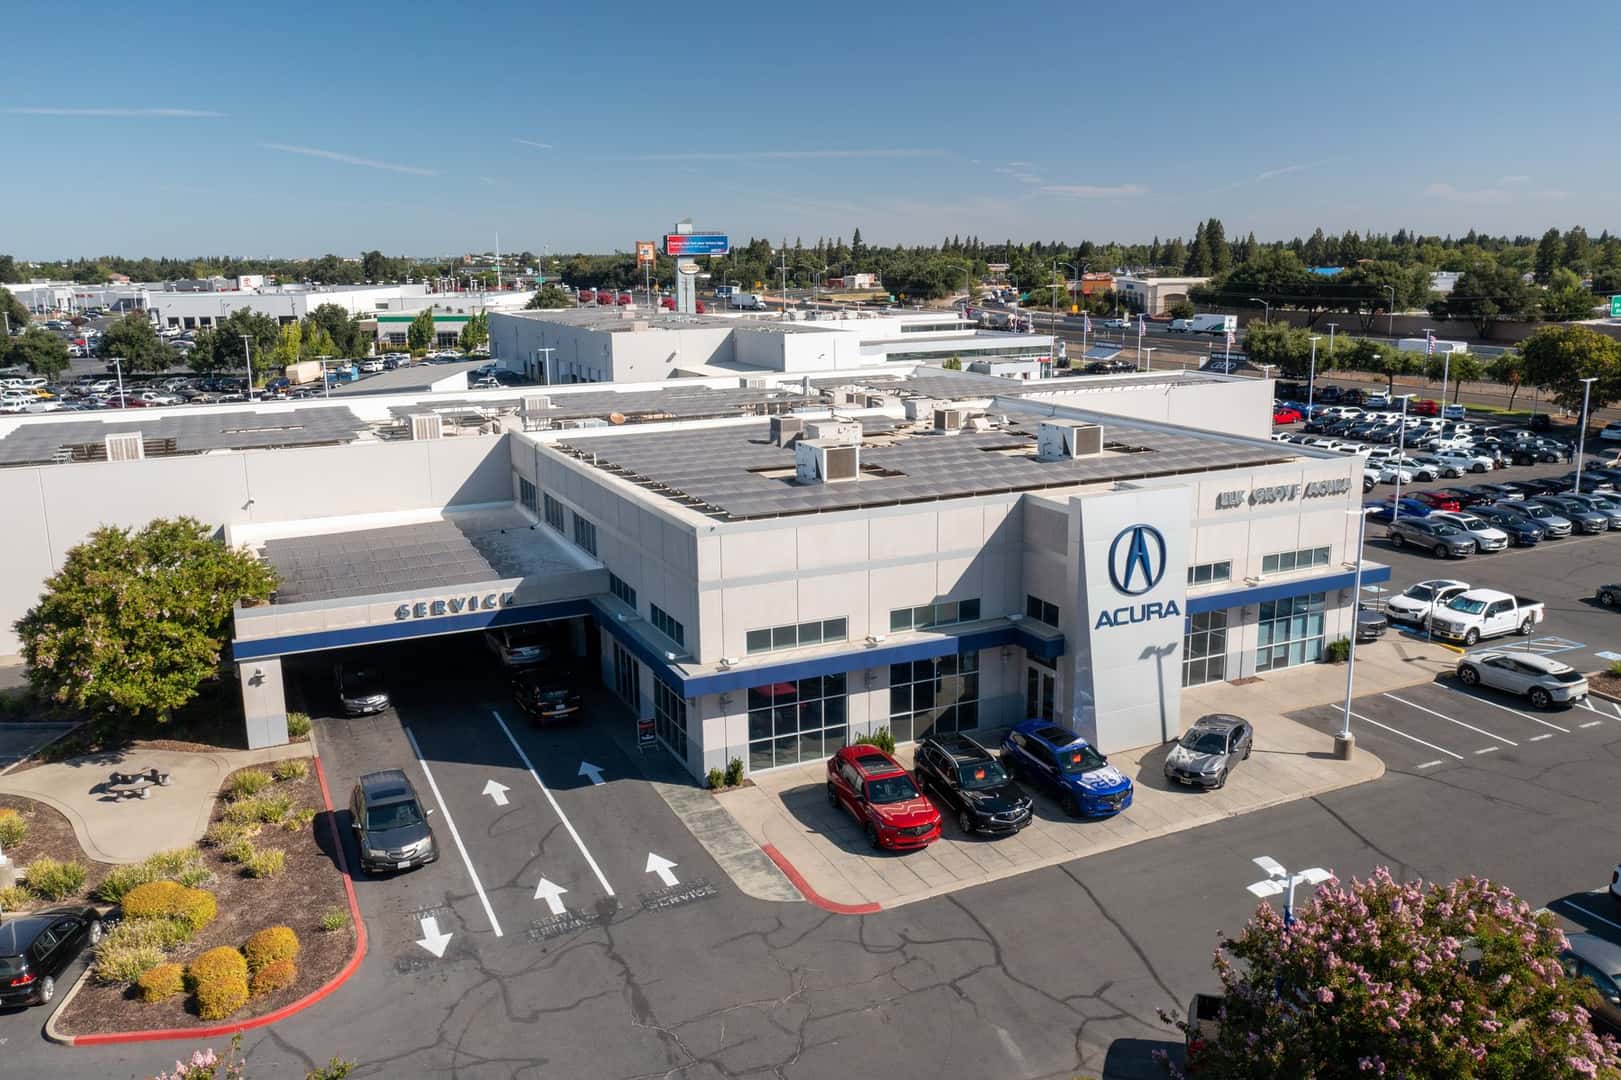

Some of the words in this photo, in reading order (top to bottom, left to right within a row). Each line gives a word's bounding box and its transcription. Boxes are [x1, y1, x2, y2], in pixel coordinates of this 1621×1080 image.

[1217, 490, 1246, 509] ELK
[1250, 484, 1301, 504] GROVE
[1304, 478, 1351, 498] ACURA
[1095, 600, 1180, 629] ACURA
